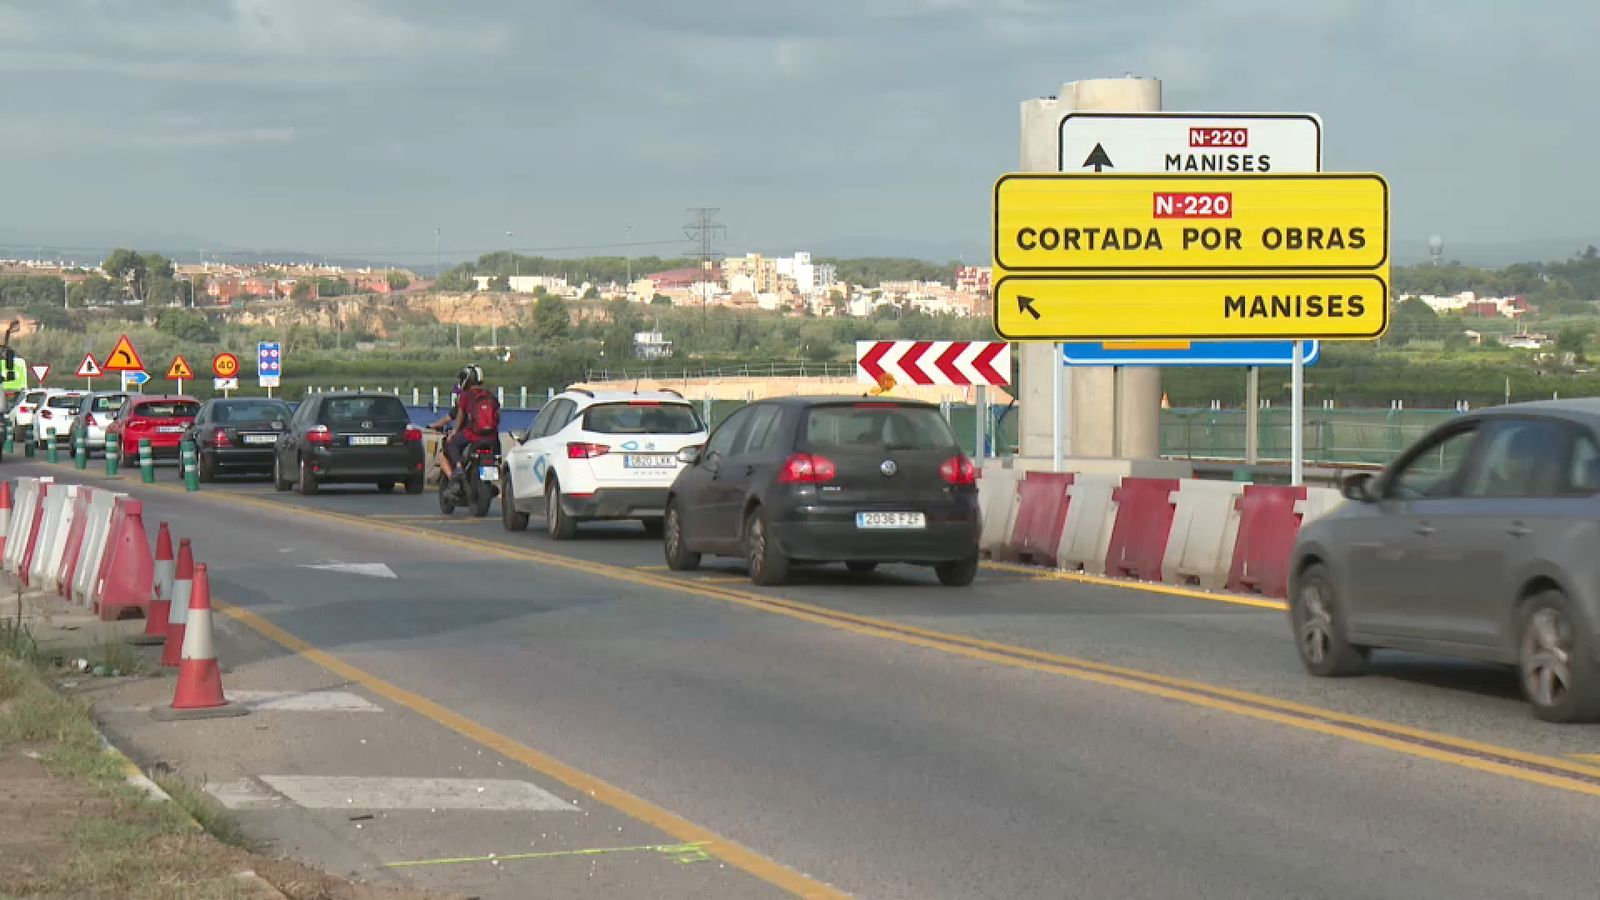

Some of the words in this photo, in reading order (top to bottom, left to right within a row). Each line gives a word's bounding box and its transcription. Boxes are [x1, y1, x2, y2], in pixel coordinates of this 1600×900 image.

[1190, 129, 1246, 146] N-220
[1165, 154, 1271, 172] MANISES
[1155, 195, 1230, 216] N-220
[1016, 227, 1163, 251] CORTADA
[1182, 227, 1242, 251] POR
[1262, 227, 1366, 250] OBRAS
[1224, 295, 1365, 318] MANISES
[218, 360, 234, 369] 40
[866, 513, 896, 525] 2036
